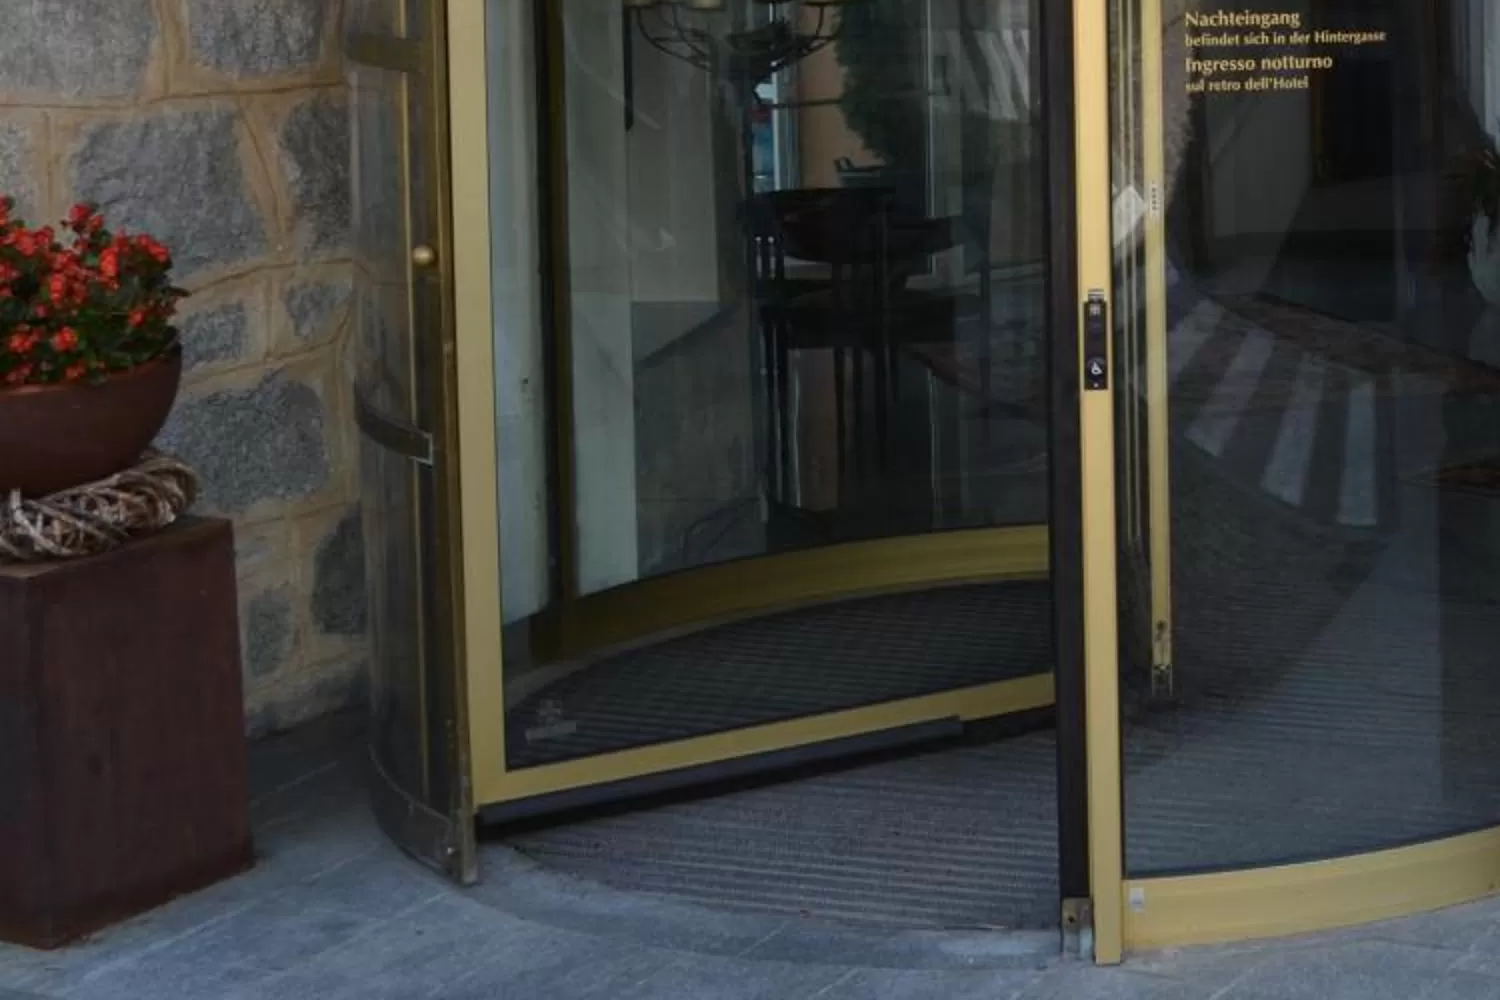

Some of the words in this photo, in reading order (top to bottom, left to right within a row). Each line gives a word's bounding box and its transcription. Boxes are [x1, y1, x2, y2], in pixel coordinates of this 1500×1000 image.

[1184, 9, 1301, 29] Nachteingang
[1184, 32, 1240, 48] befindet
[1243, 30, 1270, 46] sich
[1273, 31, 1286, 45] in
[1289, 30, 1311, 45] der
[1313, 29, 1387, 46] Hintergasse
[1184, 57, 1256, 76] Ingresso
[1261, 54, 1333, 70] notturno
[1208, 78, 1242, 92] retro
